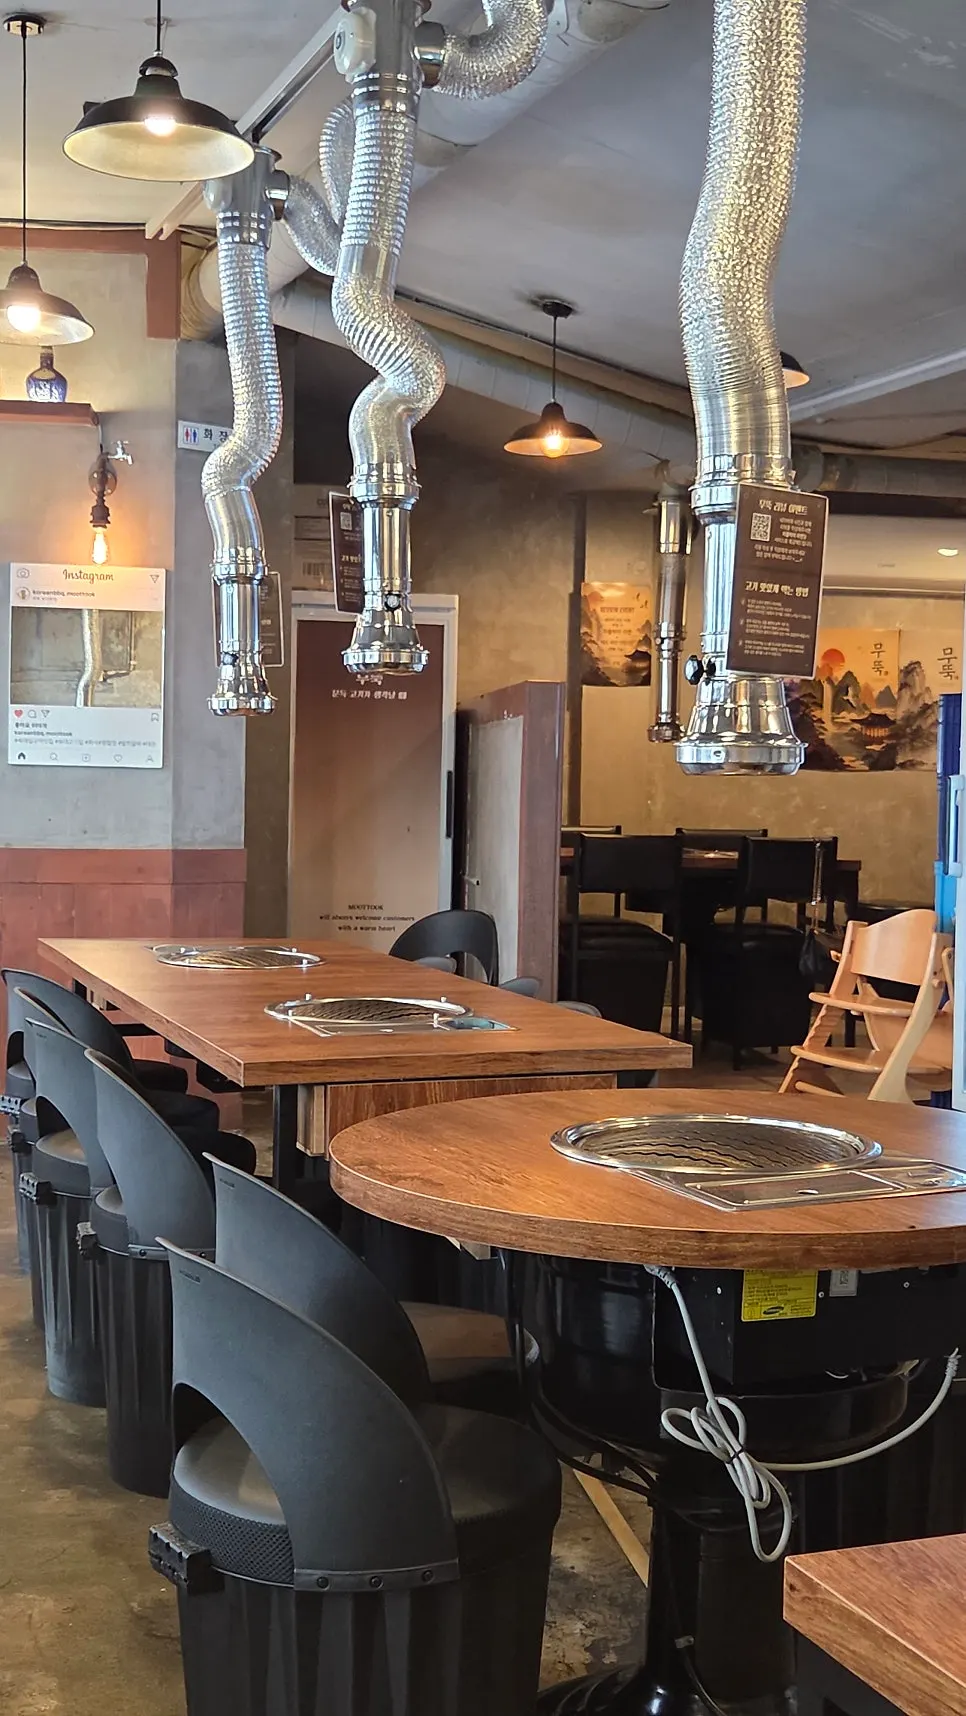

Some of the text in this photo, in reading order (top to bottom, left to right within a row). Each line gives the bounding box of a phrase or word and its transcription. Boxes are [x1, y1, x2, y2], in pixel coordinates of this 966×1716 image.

[62, 568, 114, 585] Instagram
[745, 581, 809, 597] 고기 맛있게 먹는 방법
[870, 642, 886, 676] 무뚝
[937, 647, 958, 680] 무뚝
